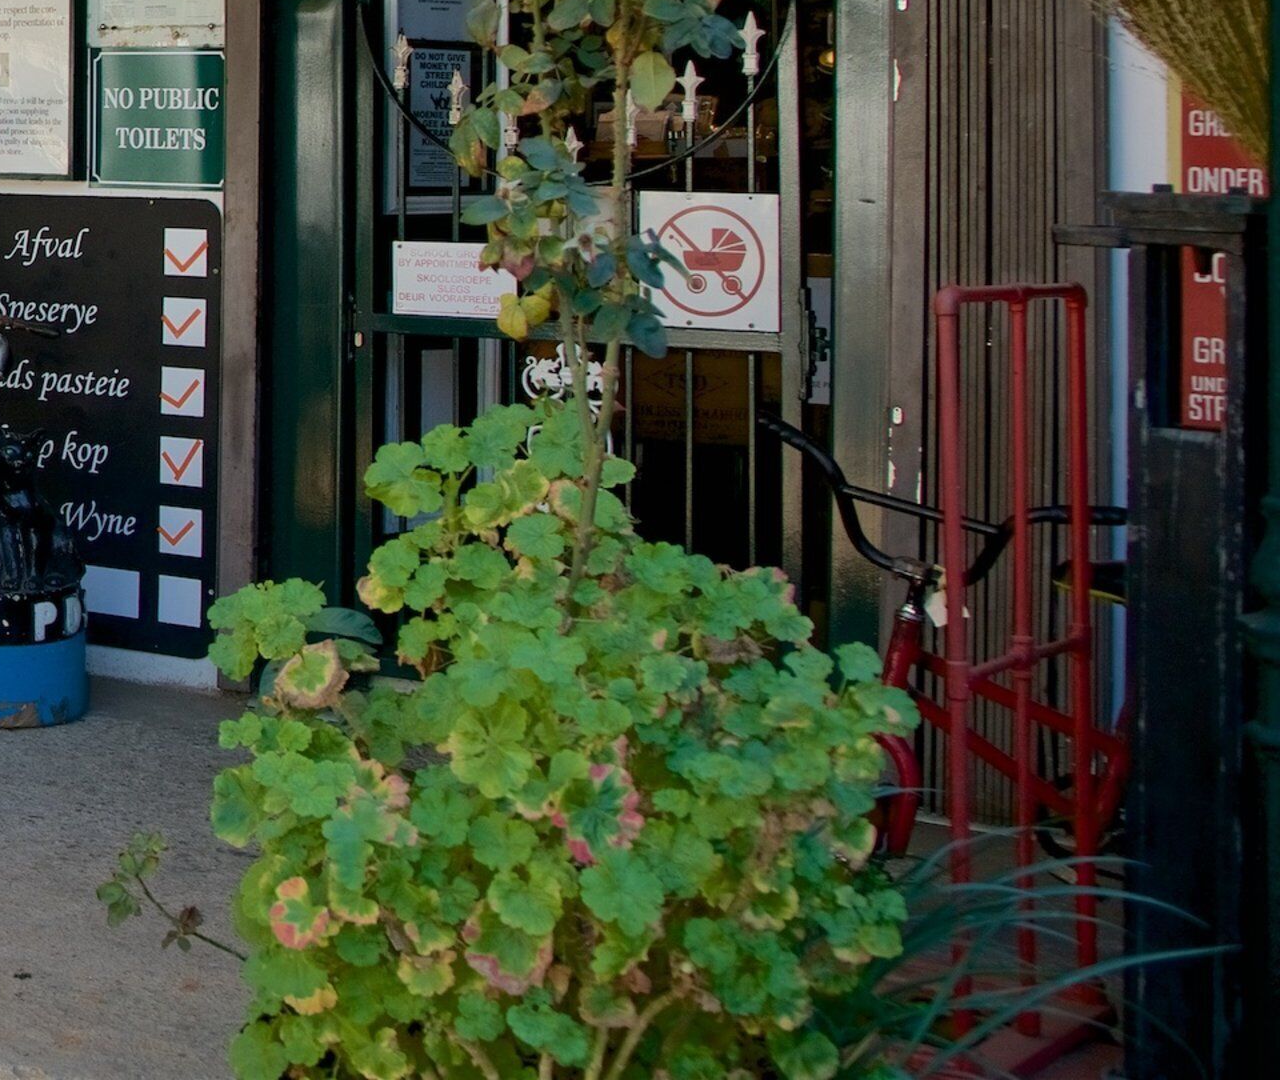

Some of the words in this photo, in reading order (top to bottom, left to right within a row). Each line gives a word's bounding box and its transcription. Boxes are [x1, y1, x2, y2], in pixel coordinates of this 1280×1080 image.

[425, 71, 453, 80] STREE
[104, 88, 134, 110] NO
[139, 87, 219, 110] PUBLIC
[116, 127, 206, 151] TOILETS
[1187, 166, 1265, 195] ONDER
[4, 226, 90, 265] Afval
[37, 366, 130, 402] pasteie
[61, 431, 110, 473] kop
[60, 502, 137, 541] Wyne
